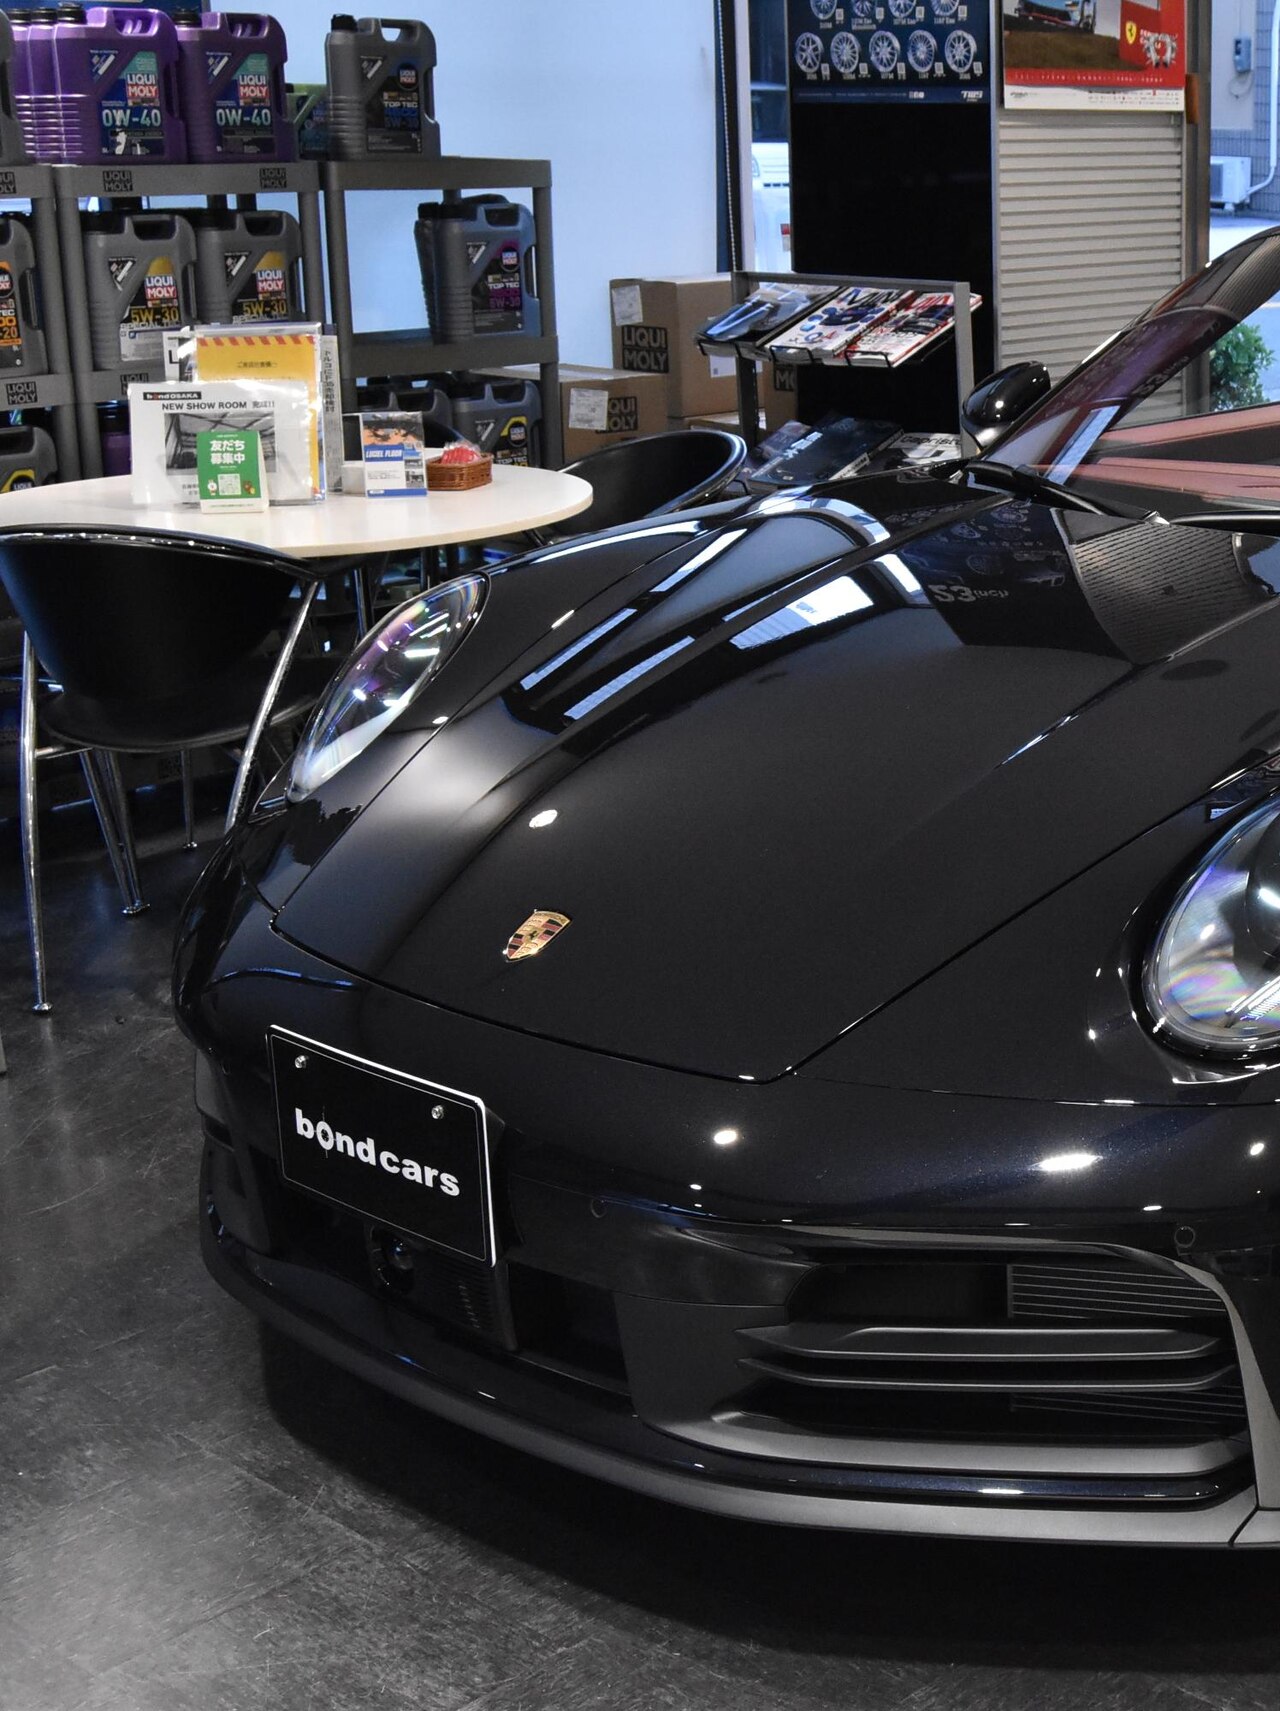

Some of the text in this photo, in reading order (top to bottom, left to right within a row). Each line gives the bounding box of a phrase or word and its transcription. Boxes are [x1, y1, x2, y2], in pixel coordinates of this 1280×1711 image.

[126, 74, 156, 85] LIQUI
[239, 74, 267, 85] LIQUI
[128, 86, 158, 97] MOLY
[240, 86, 268, 97] MOLY
[102, 108, 161, 127] 0W-40
[216, 108, 272, 126] 0W-40
[104, 172, 131, 182] LIQUI
[105, 181, 133, 192] MOLY
[257, 270, 282, 280] LIQUI
[145, 276, 174, 287] LIQUI
[258, 280, 284, 290] MOLY
[147, 287, 176, 298] MOLY
[242, 300, 287, 317] 5W-30
[130, 306, 179, 324] 5W-30
[622, 328, 667, 348] LIQUI
[623, 351, 668, 372] MOLY
[7, 382, 36, 393] LIQUI
[8, 393, 38, 404] MOLY
[162, 402, 184, 411] NEW
[186, 402, 215, 410] SHOW
[218, 401, 247, 409] ROOM
[608, 398, 636, 414] QUI
[608, 415, 637, 431] OLY
[210, 440, 246, 452] 友だち
